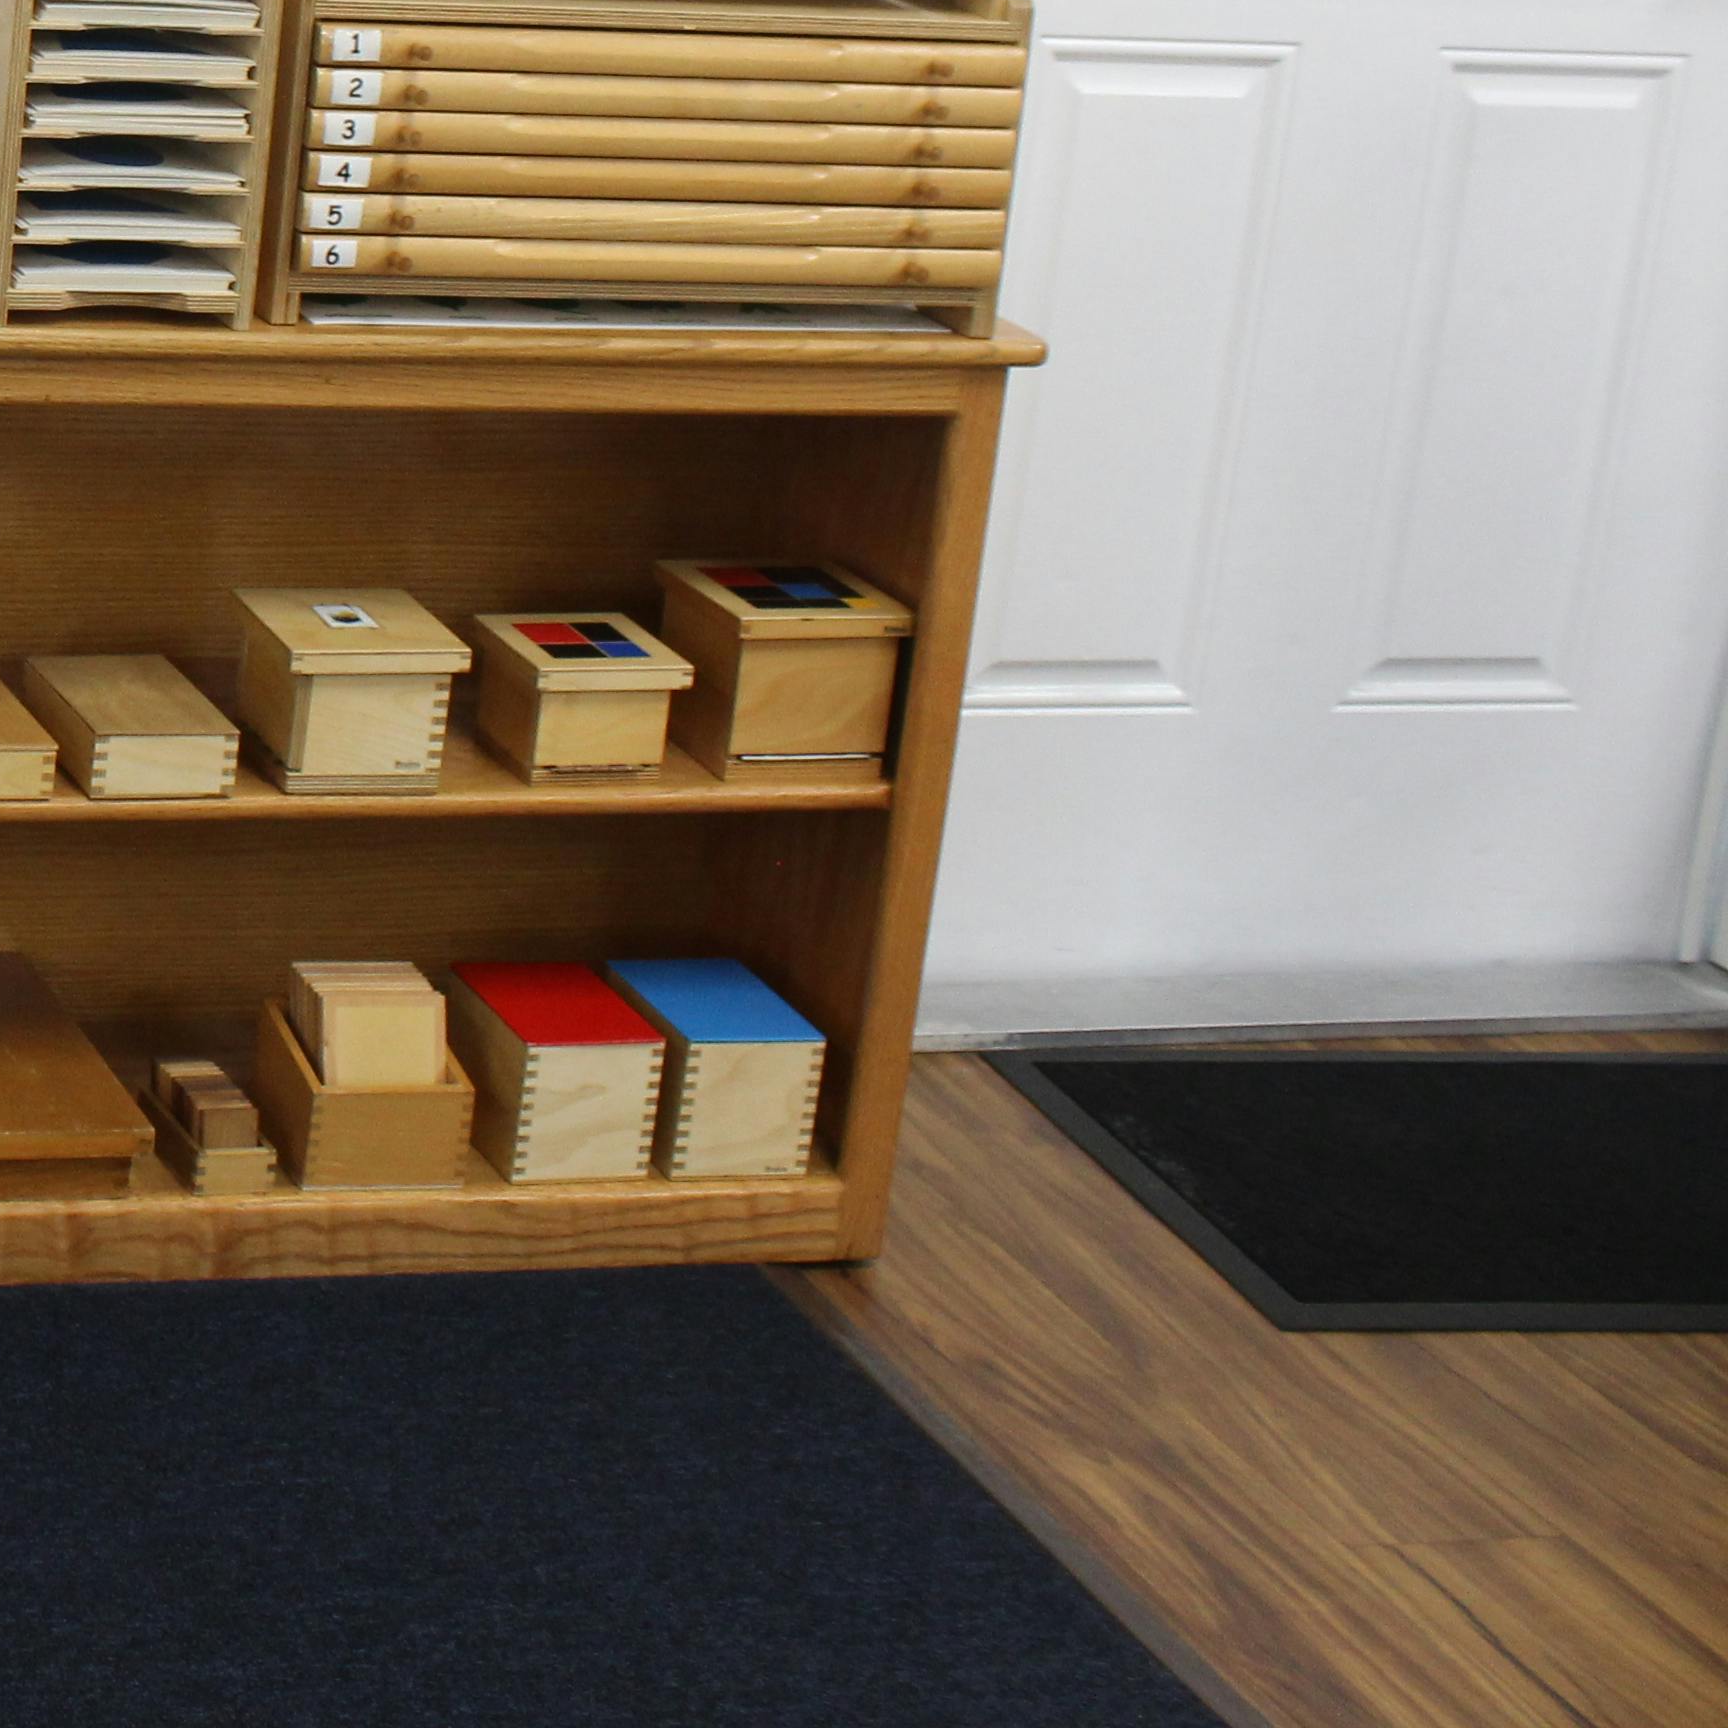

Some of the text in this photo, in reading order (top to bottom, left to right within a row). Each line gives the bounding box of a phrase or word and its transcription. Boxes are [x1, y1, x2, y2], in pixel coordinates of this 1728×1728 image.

[351, 34, 360, 54] 1
[348, 78, 363, 98] 2
[342, 120, 355, 140] 3
[336, 163, 351, 182] 4
[327, 205, 342, 226] 5
[325, 246, 340, 265] 6
